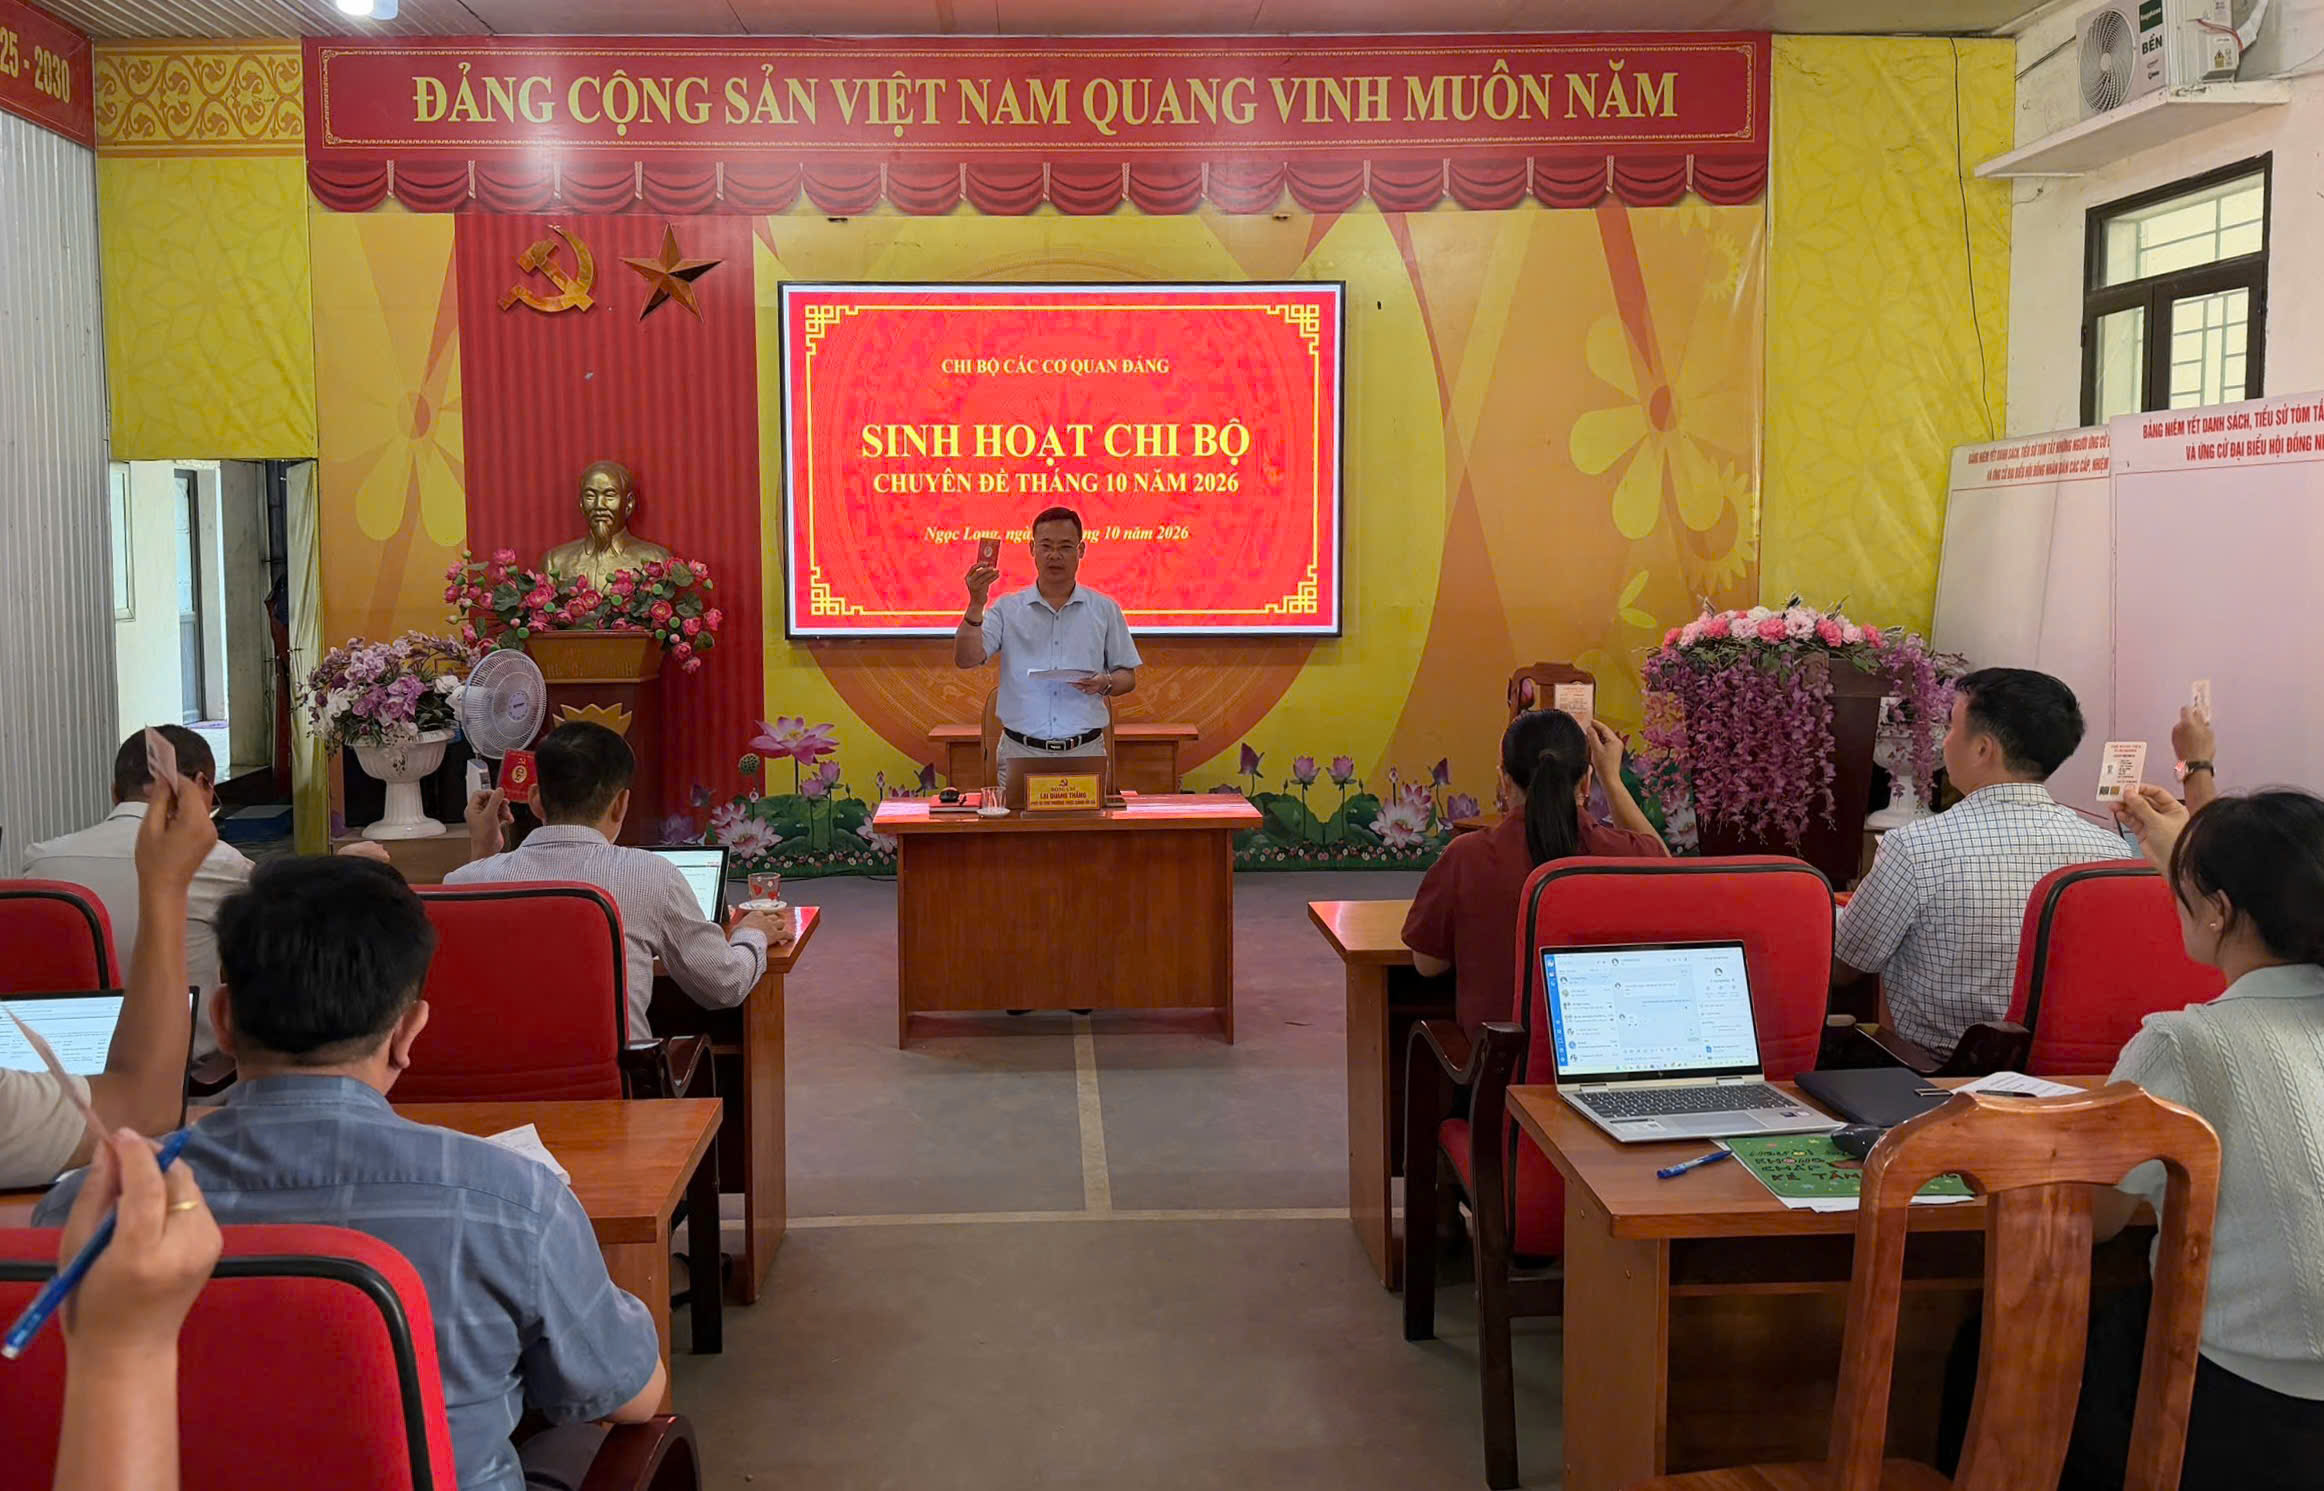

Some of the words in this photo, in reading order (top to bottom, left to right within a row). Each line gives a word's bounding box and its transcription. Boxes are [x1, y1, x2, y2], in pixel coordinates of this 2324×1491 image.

[34, 45, 70, 104] 2030
[412, 62, 556, 124] ĐẢNG
[567, 69, 713, 137] CỘNG
[725, 63, 819, 125] SẢN
[830, 72, 946, 138] VIỆT
[957, 79, 1070, 124] NAM
[1083, 77, 1258, 136] QUANG
[1268, 77, 1392, 123] VINH
[1403, 59, 1550, 121] MUÔN
[1564, 58, 1678, 118] NĂM
[941, 358, 972, 374] CHI
[976, 357, 1000, 377] BỘ
[1003, 355, 1038, 374] CÁC
[1042, 358, 1067, 374] CƠ
[1070, 358, 1117, 377] QUAN
[1122, 355, 1169, 374] ĐẢNG
[2187, 414, 2200, 434] YẾT
[2202, 415, 2225, 433] DANH
[2227, 411, 2252, 431] SÁCH,
[2254, 404, 2273, 428] TIỂU
[2290, 403, 2310, 425] TÓM
[861, 424, 962, 458] SINH
[973, 424, 1093, 466] HOẠT
[1103, 423, 1180, 458] CHI
[1192, 418, 1250, 466] BỘ
[2230, 440, 2245, 461] ĐẠI
[2247, 433, 2267, 457] BIỂU
[2269, 434, 2284, 459] HỘI
[2287, 431, 2312, 453] ĐỒNG
[873, 467, 972, 493] CHUYÊN
[978, 467, 1010, 493] ĐỀ
[1015, 467, 1098, 493] THÁNG
[1107, 473, 1128, 492] 10
[1133, 467, 1187, 493] NĂM
[1193, 472, 1239, 493] 2026
[924, 526, 959, 544] Ngọc
[1005, 524, 1036, 544] ngà
[1105, 526, 1121, 540] 10
[1123, 525, 1153, 540] năm
[1156, 525, 1189, 540] 2026
